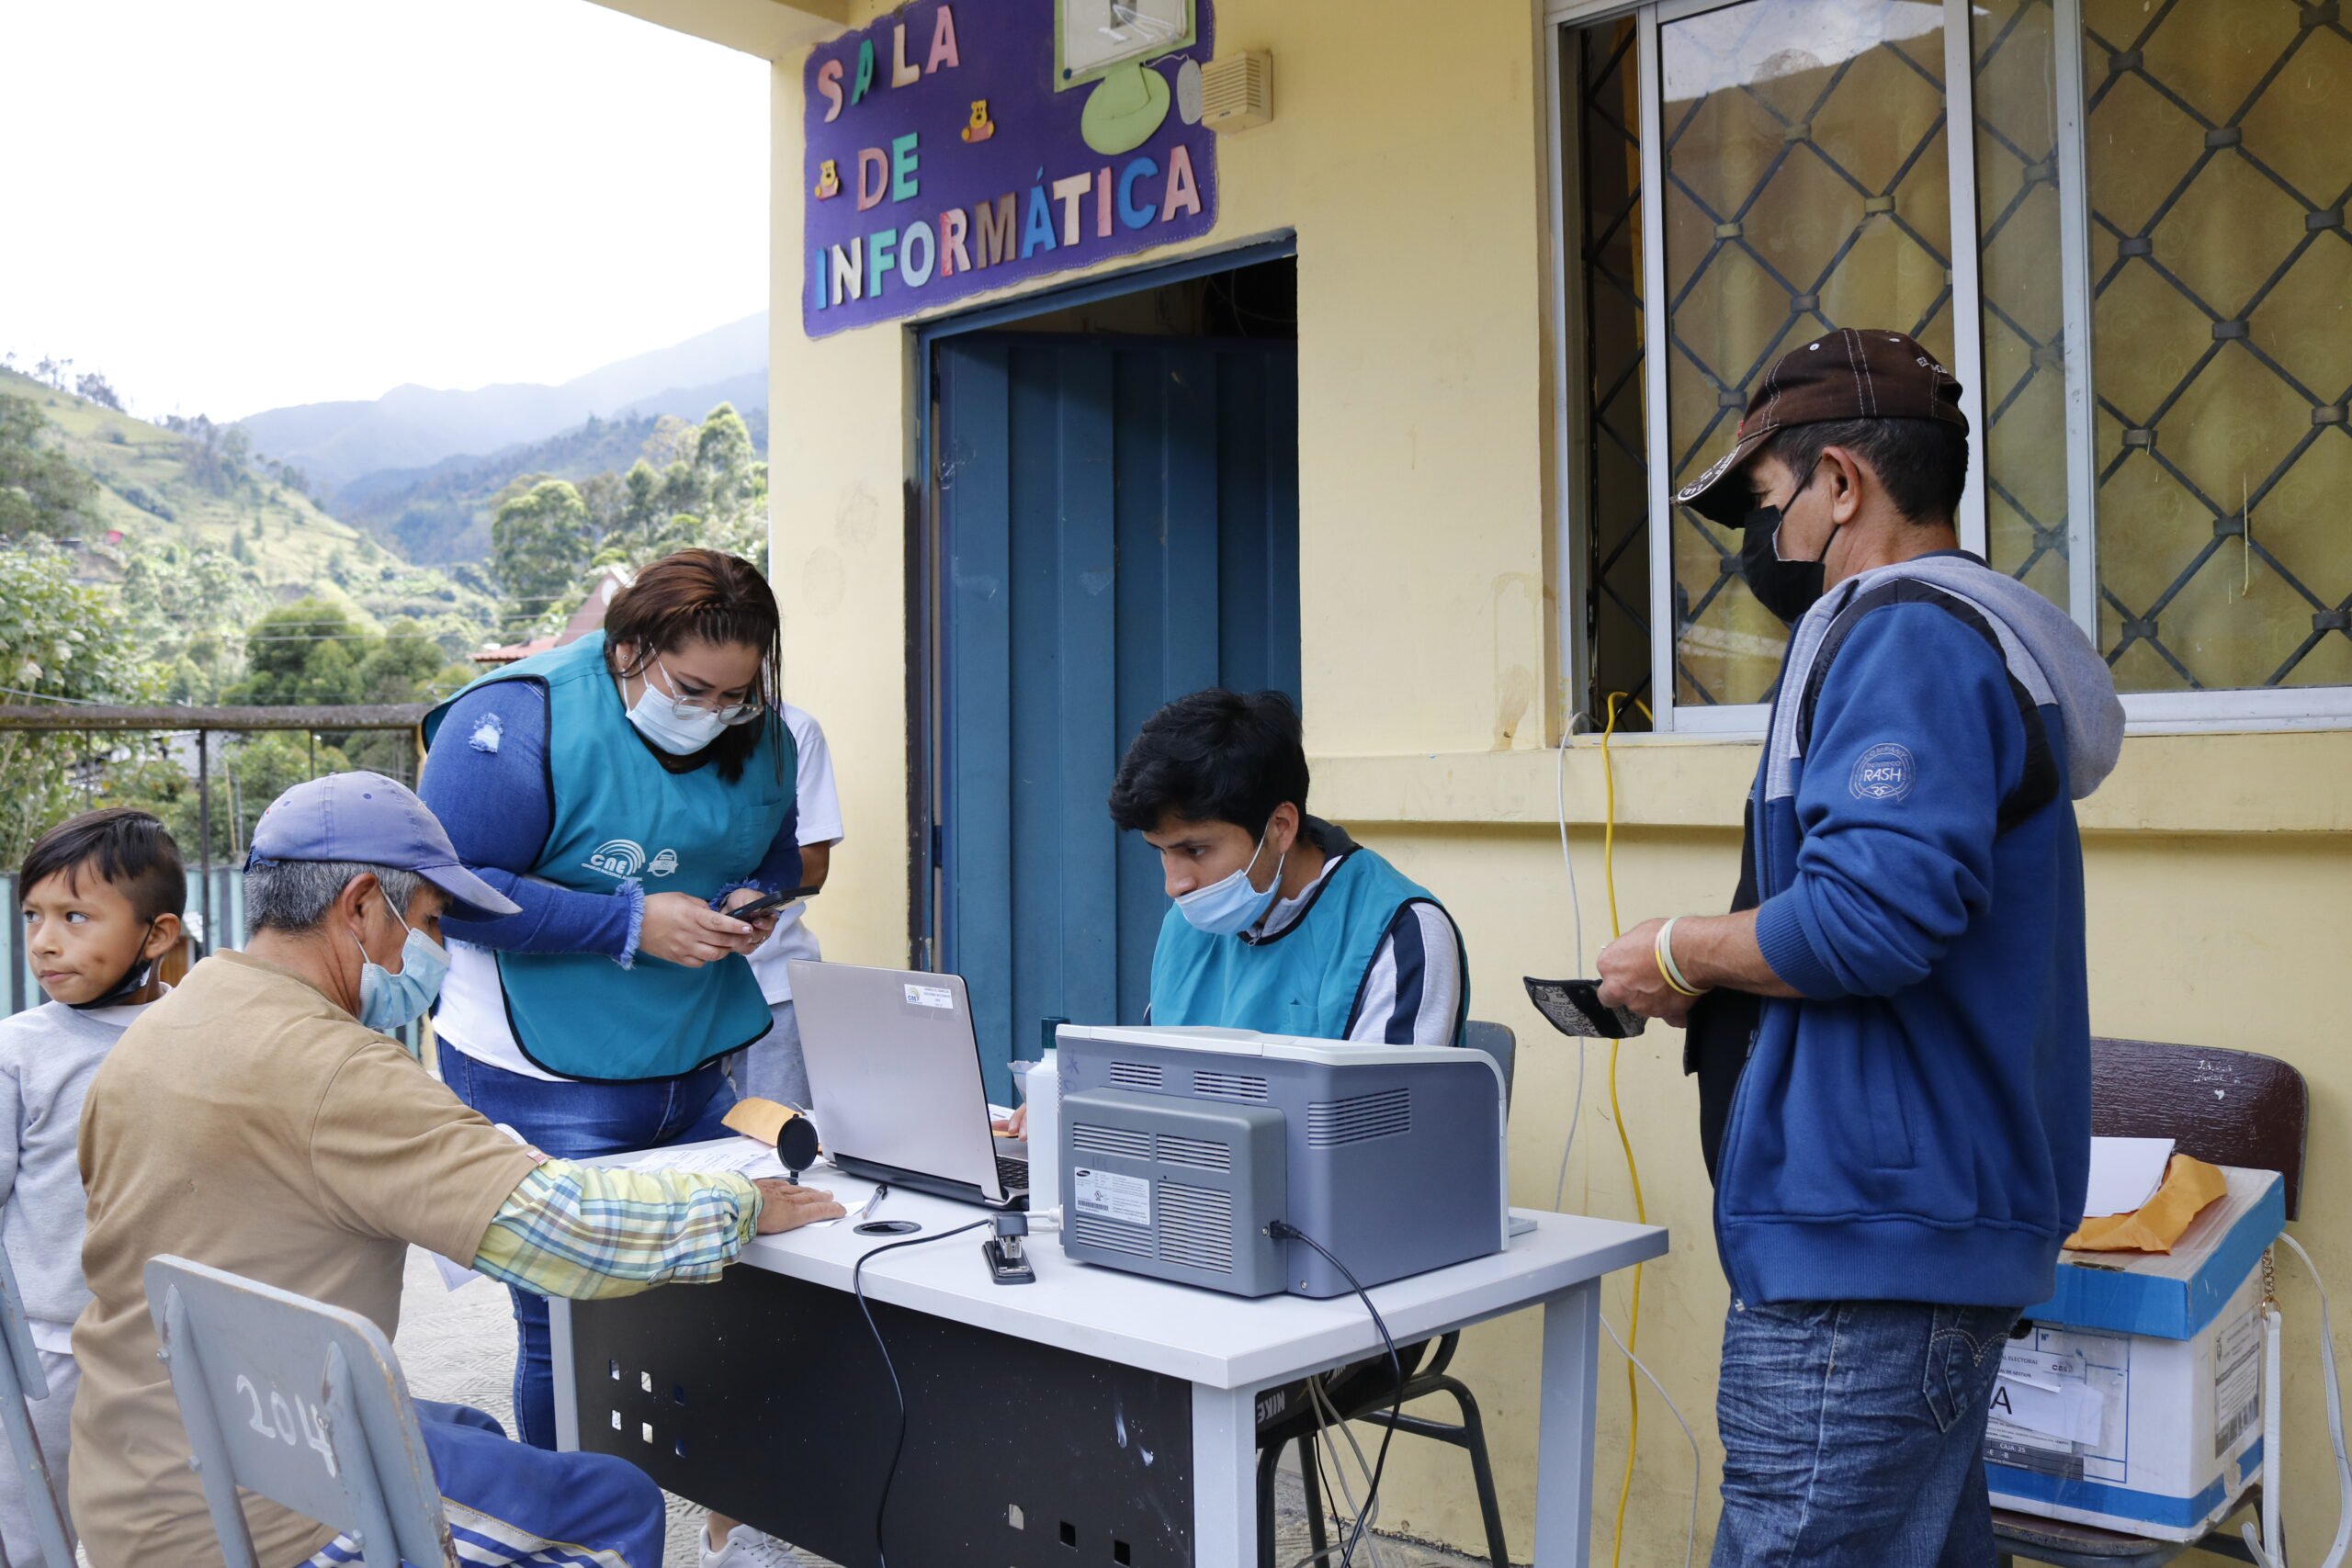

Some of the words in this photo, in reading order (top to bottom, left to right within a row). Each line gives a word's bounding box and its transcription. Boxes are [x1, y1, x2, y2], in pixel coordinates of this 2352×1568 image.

[817, 5, 960, 123] SALA
[856, 131, 919, 212] DE
[814, 144, 1202, 310] INFORMÁTICA
[1863, 767, 1902, 783] RASH
[1257, 1390, 1285, 1424] NIKE
